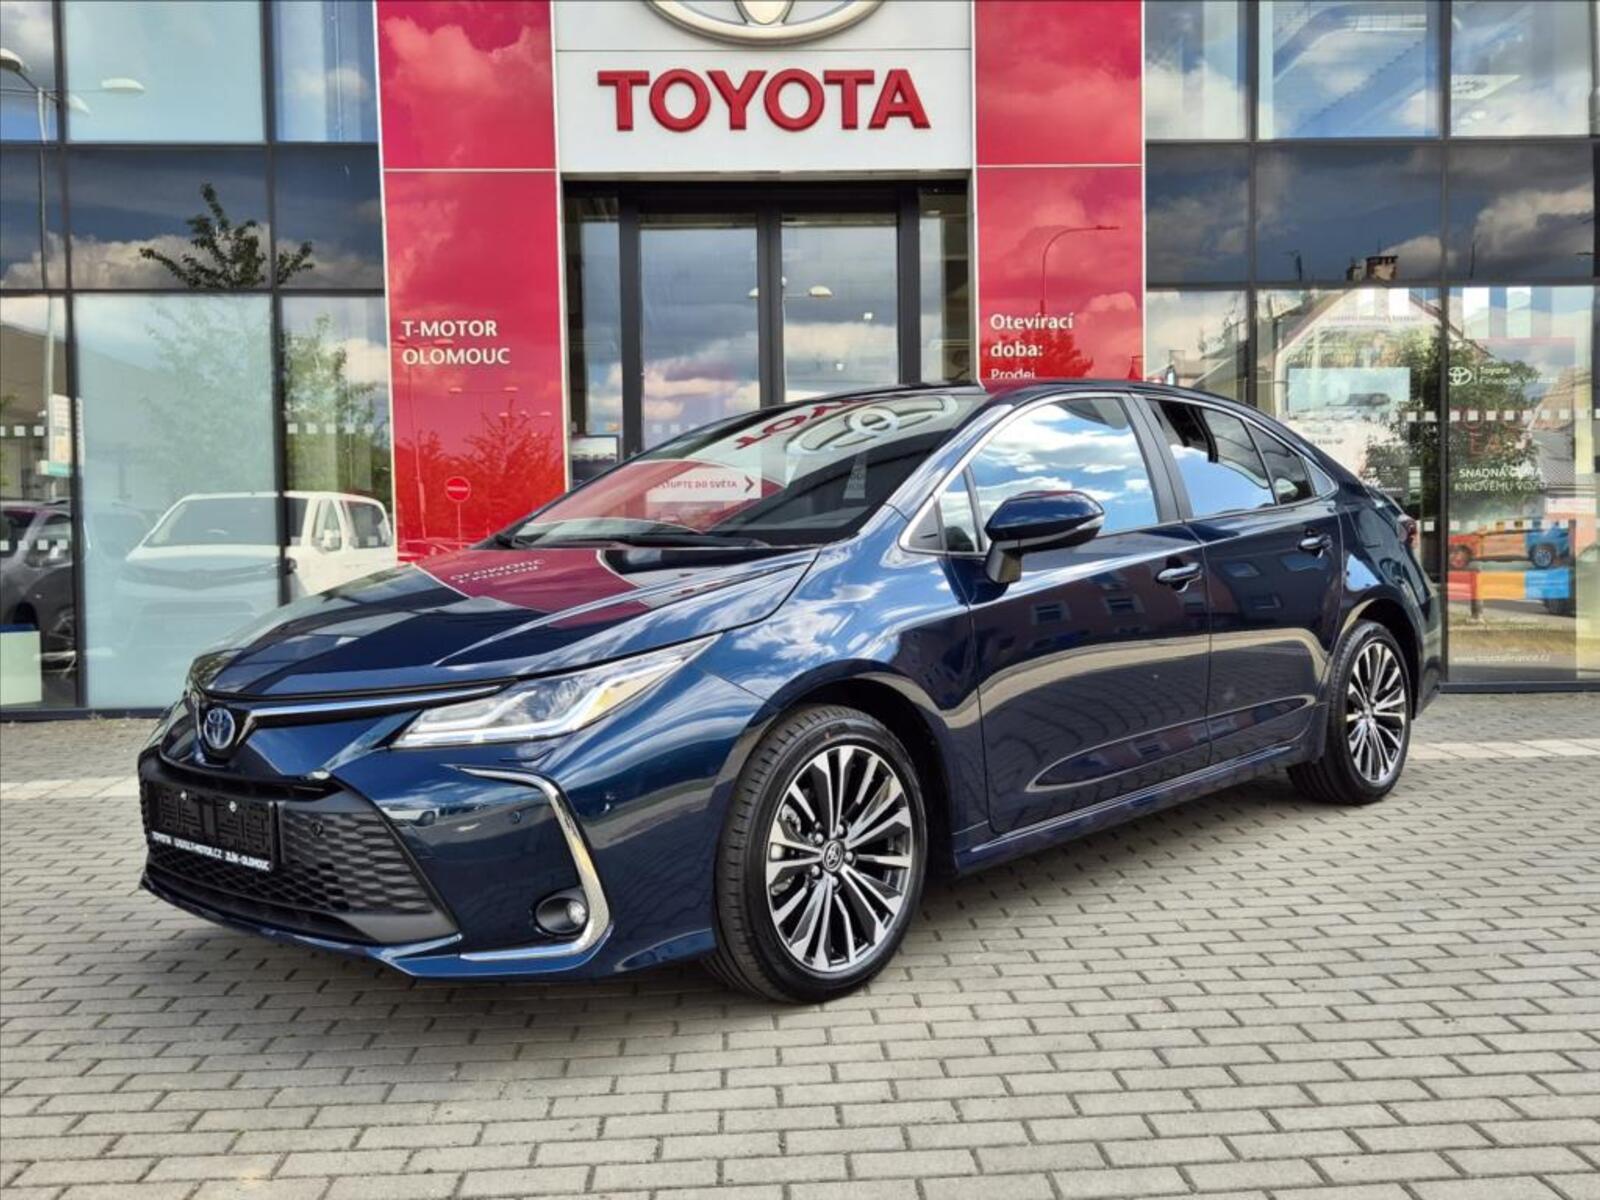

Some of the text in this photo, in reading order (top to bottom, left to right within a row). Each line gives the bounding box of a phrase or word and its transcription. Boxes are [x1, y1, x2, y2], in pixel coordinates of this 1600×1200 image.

[597, 68, 932, 133] TOYOTA
[401, 320, 497, 337] T-MOTOR
[990, 311, 1074, 330] Otevírací
[402, 347, 511, 365] OLOMOUC
[990, 341, 1043, 358] doba:
